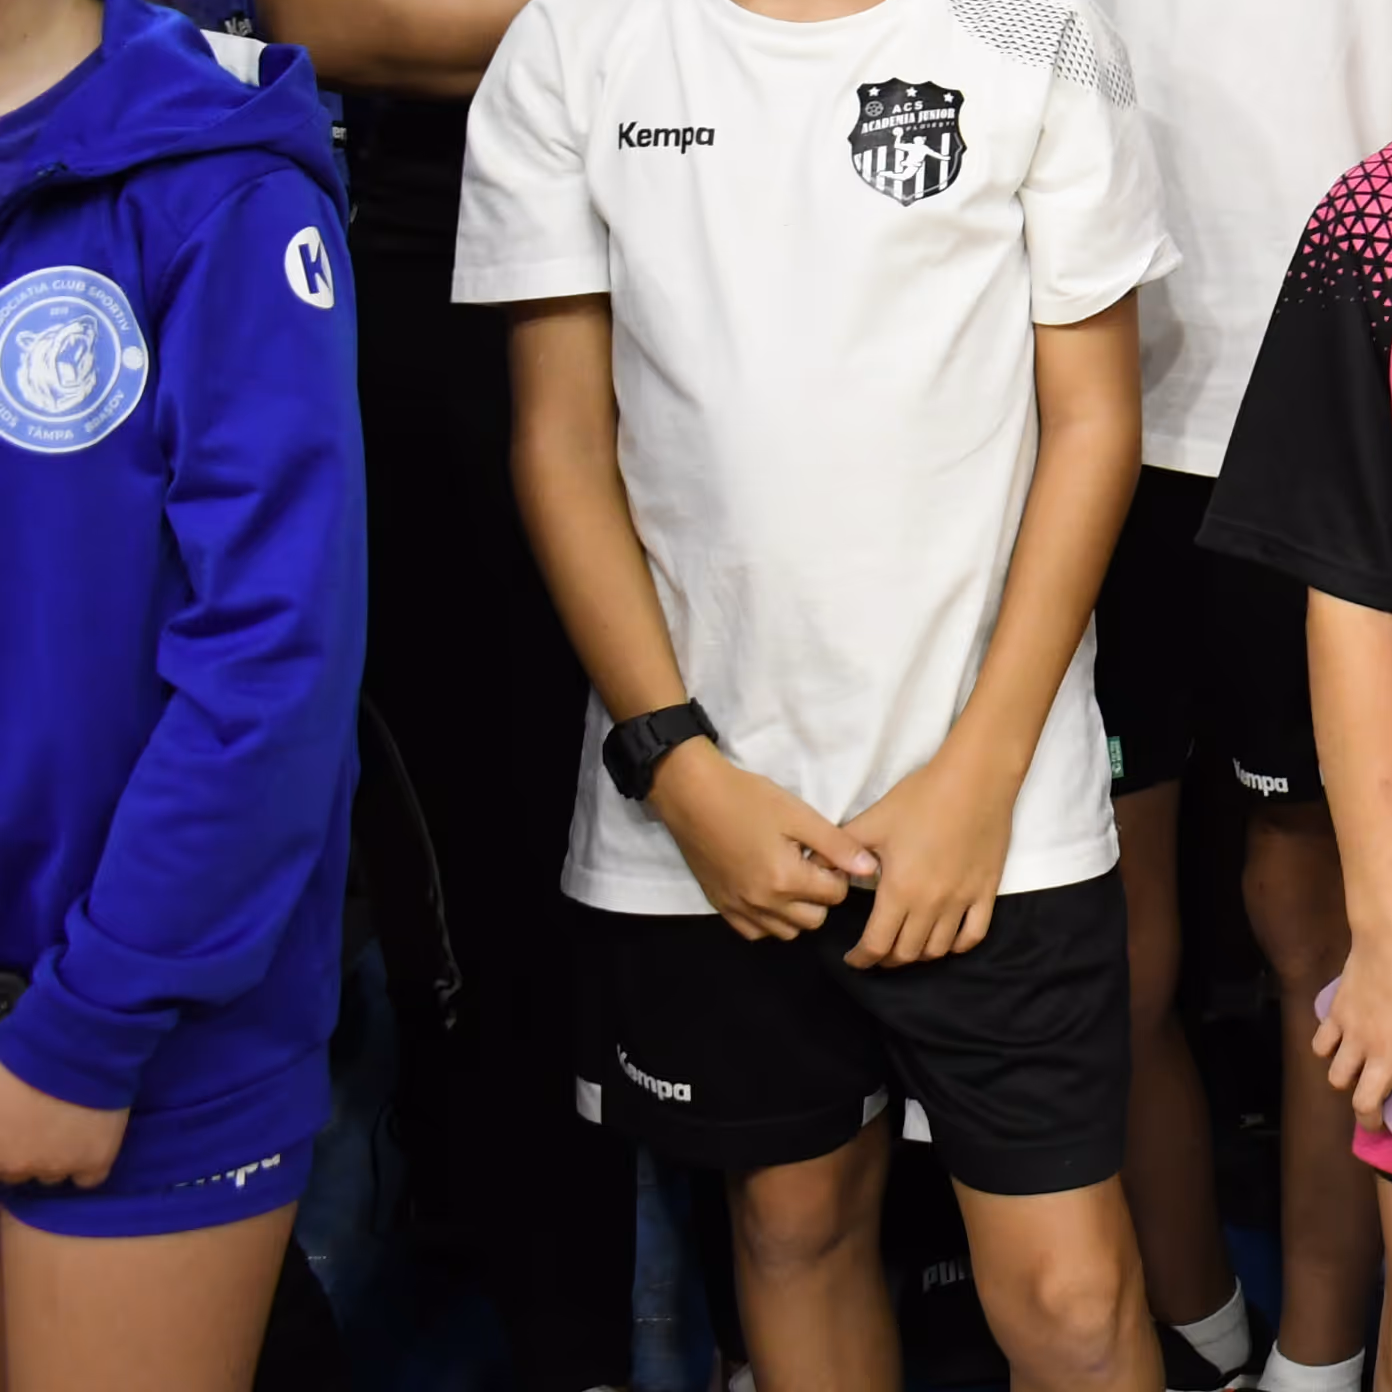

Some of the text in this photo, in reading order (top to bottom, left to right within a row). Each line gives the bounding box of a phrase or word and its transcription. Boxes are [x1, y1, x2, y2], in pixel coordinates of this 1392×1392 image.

[860, 107, 956, 134] ACADEMIA JUNIOR
[891, 100, 924, 115] ACS
[618, 121, 715, 155] Kempa
[1232, 757, 1290, 797] Kempa
[617, 1042, 692, 1102] Kempa
